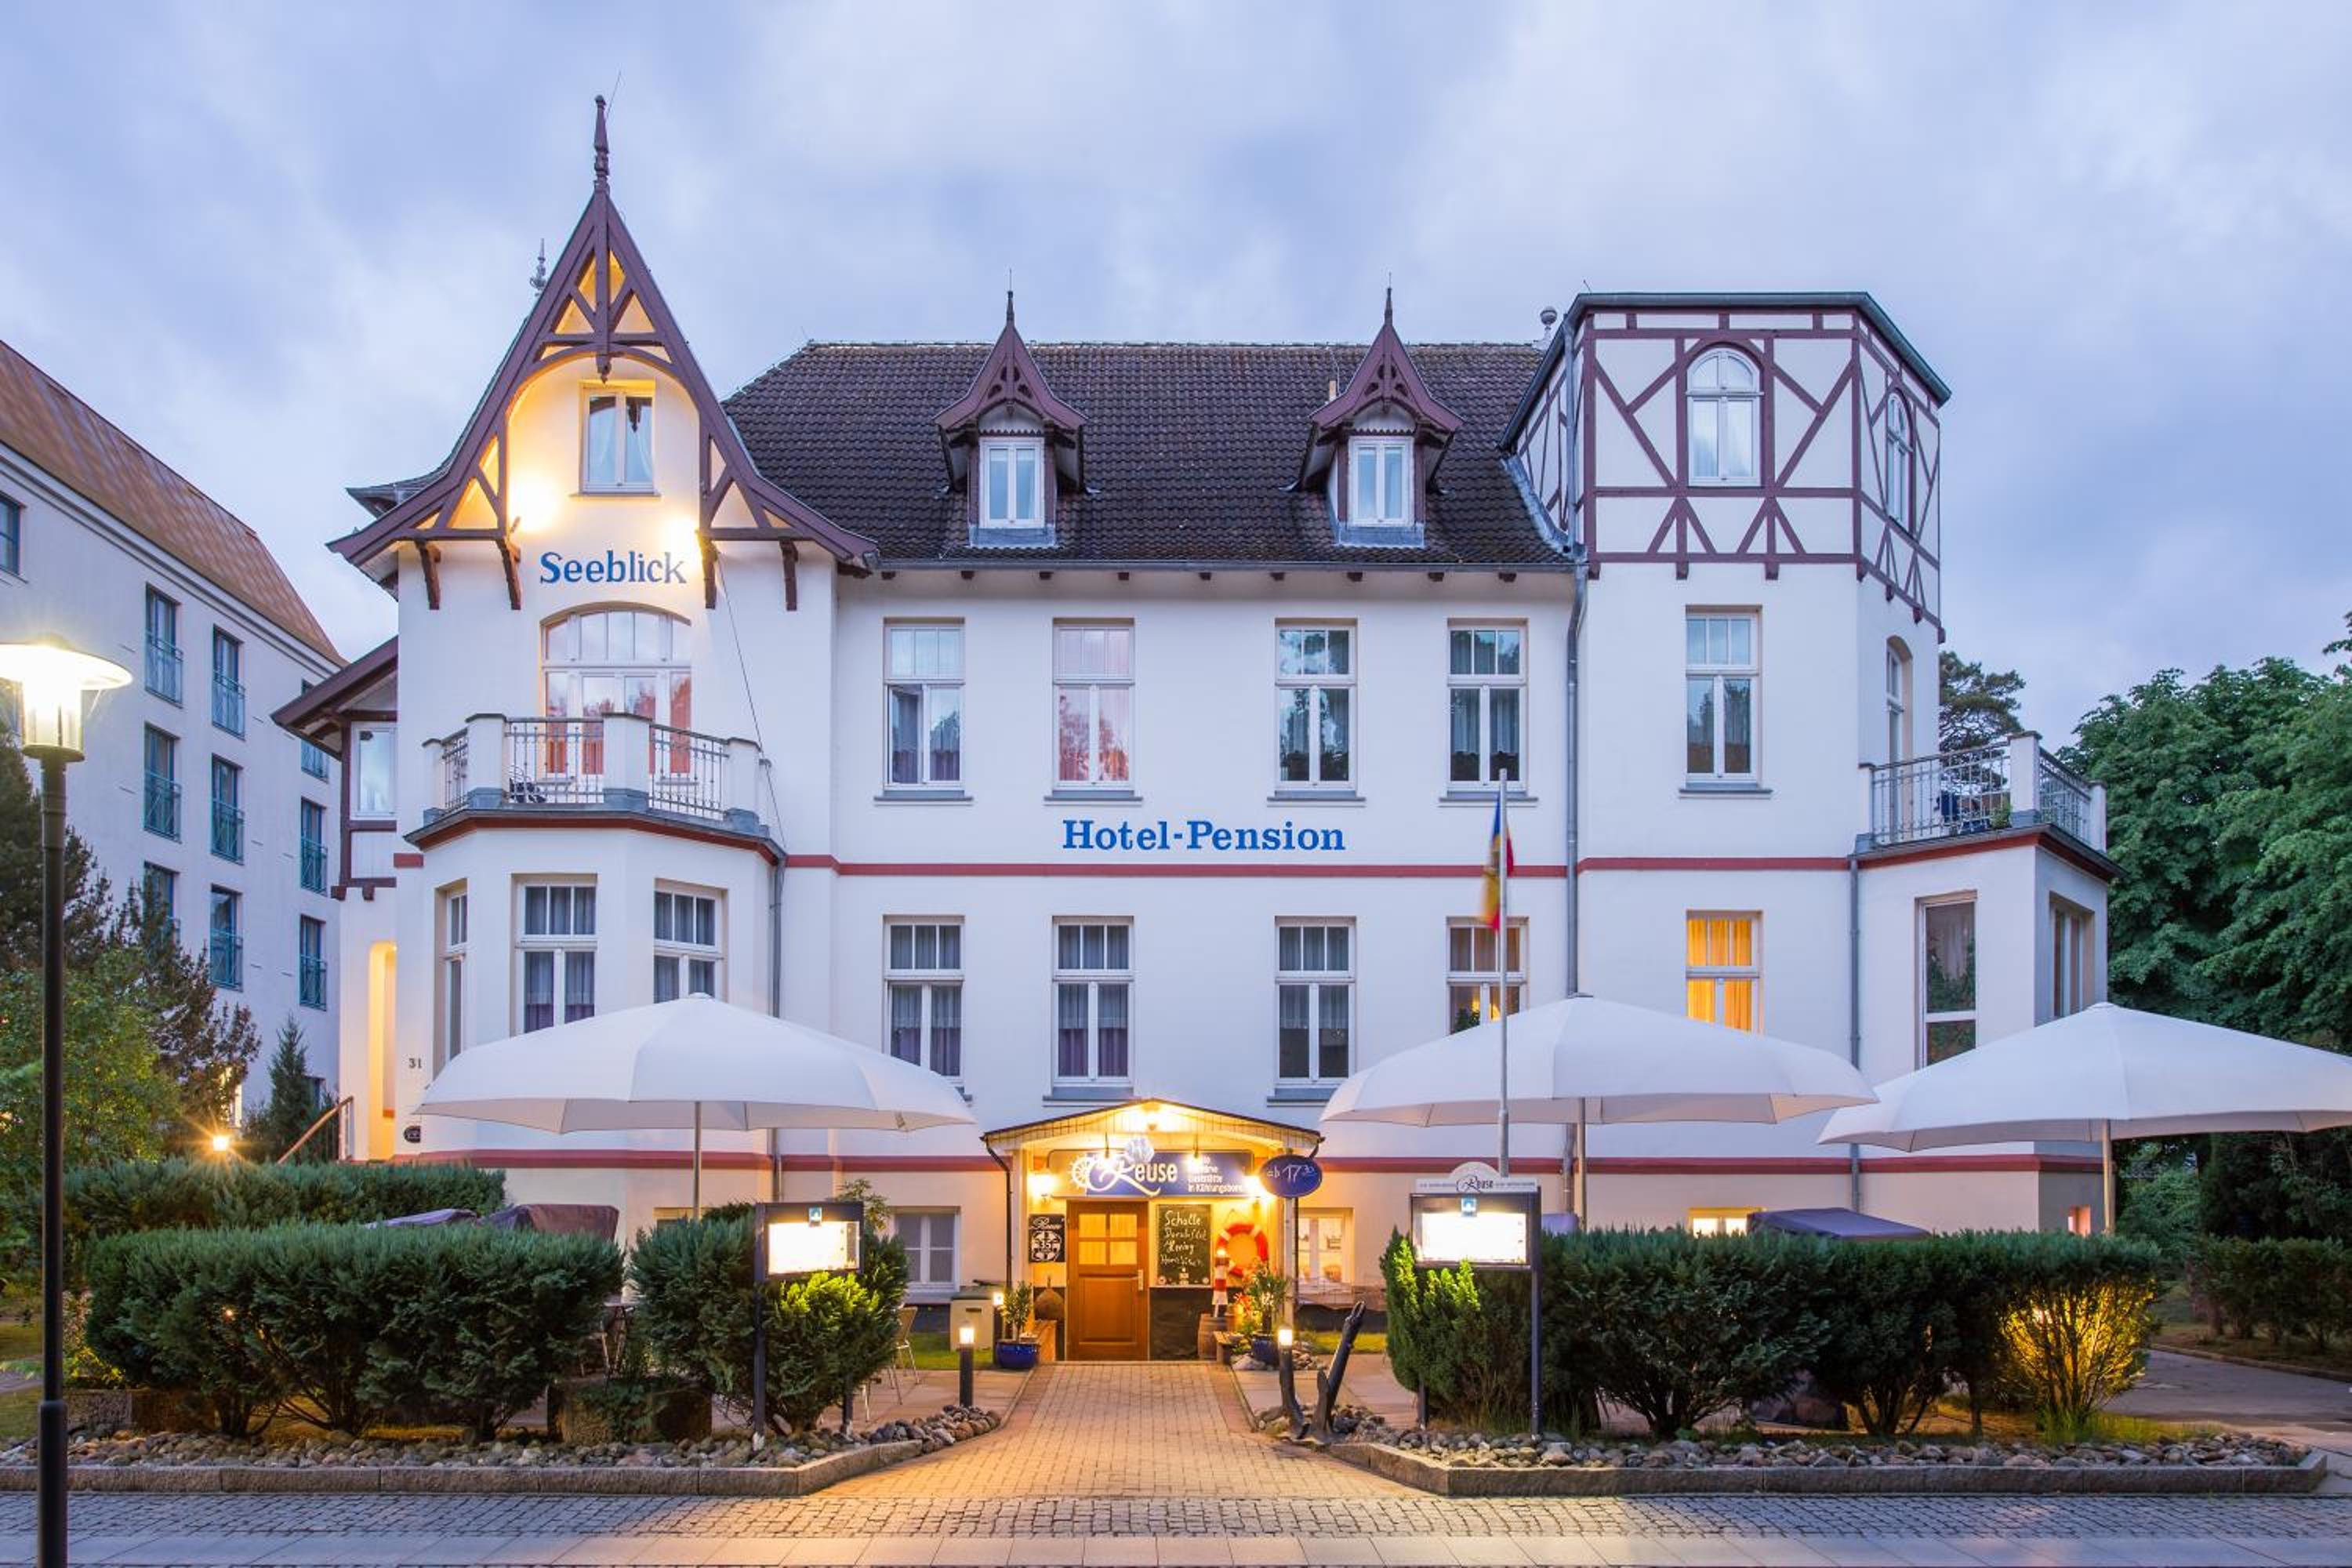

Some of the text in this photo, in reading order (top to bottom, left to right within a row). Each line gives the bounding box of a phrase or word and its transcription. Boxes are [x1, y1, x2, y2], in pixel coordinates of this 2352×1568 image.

[539, 550, 687, 584] Seeblick
[1062, 819, 1345, 851] Hotel-Pension
[408, 1058, 422, 1069] 31
